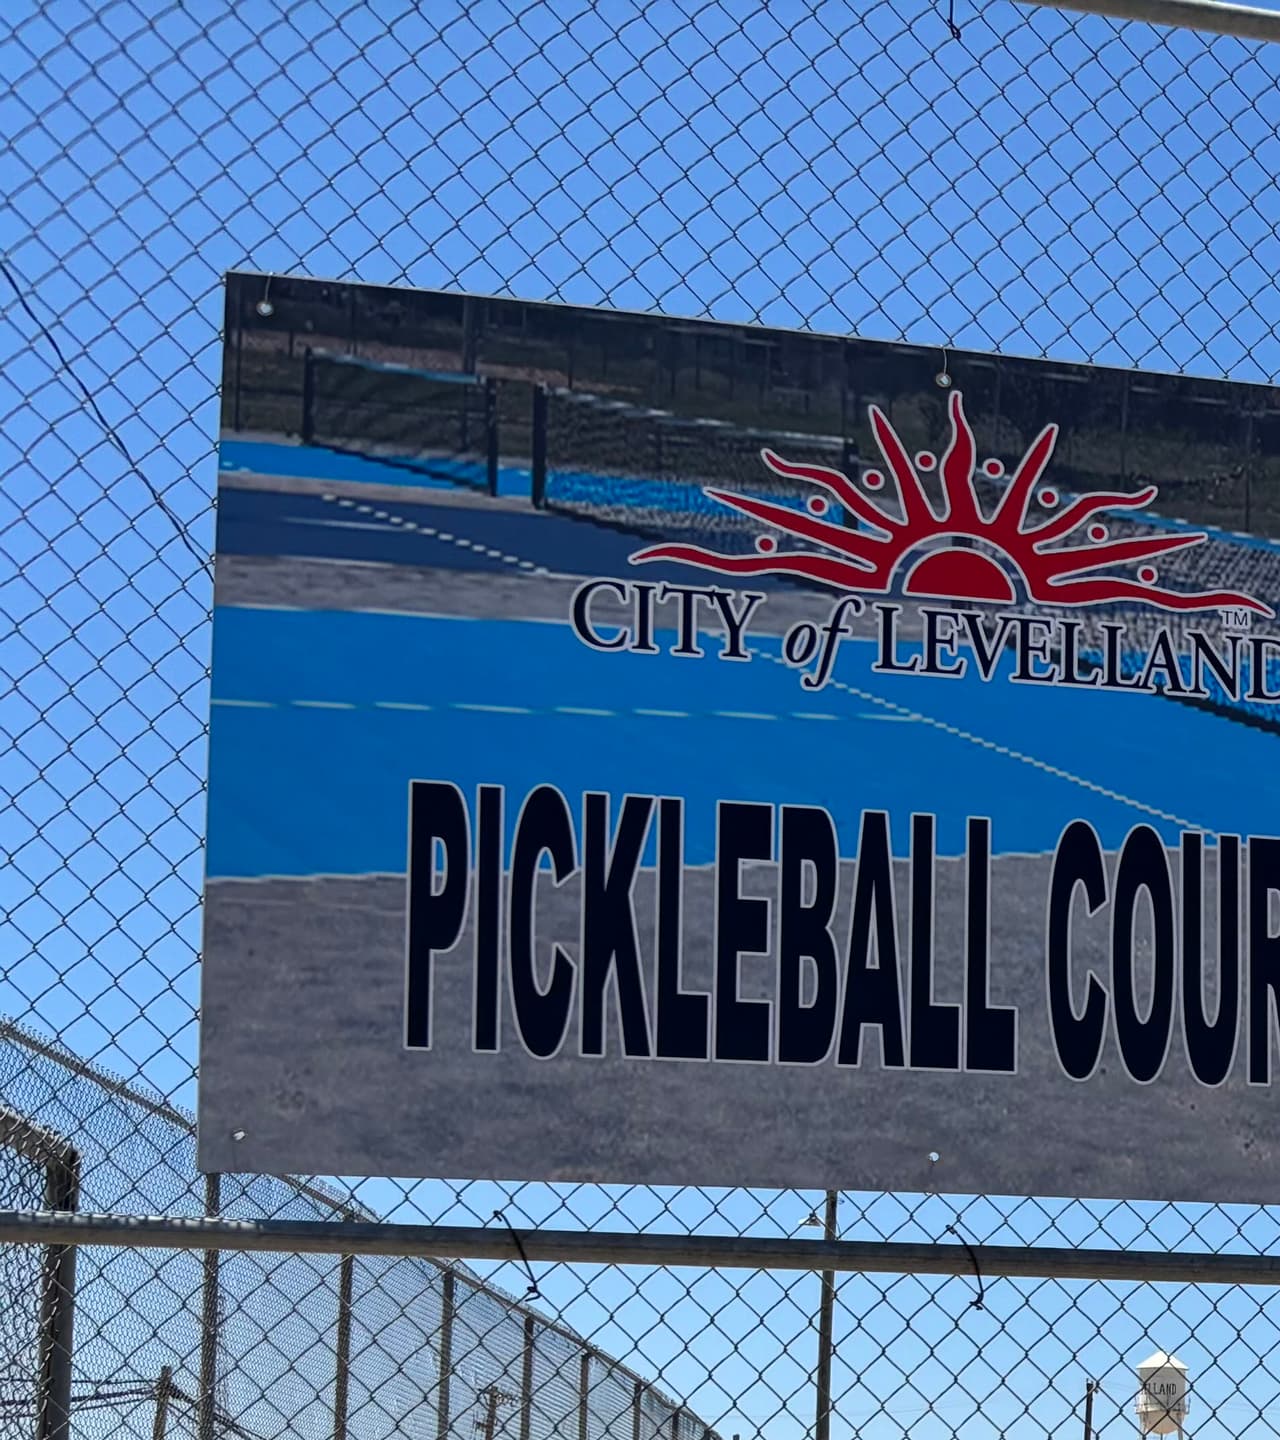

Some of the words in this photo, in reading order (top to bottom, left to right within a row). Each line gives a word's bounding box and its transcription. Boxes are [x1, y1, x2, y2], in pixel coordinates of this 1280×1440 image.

[571, 578, 765, 661] CITY
[783, 596, 864, 689] of
[404, 779, 1018, 1074] PICKLEBALL
